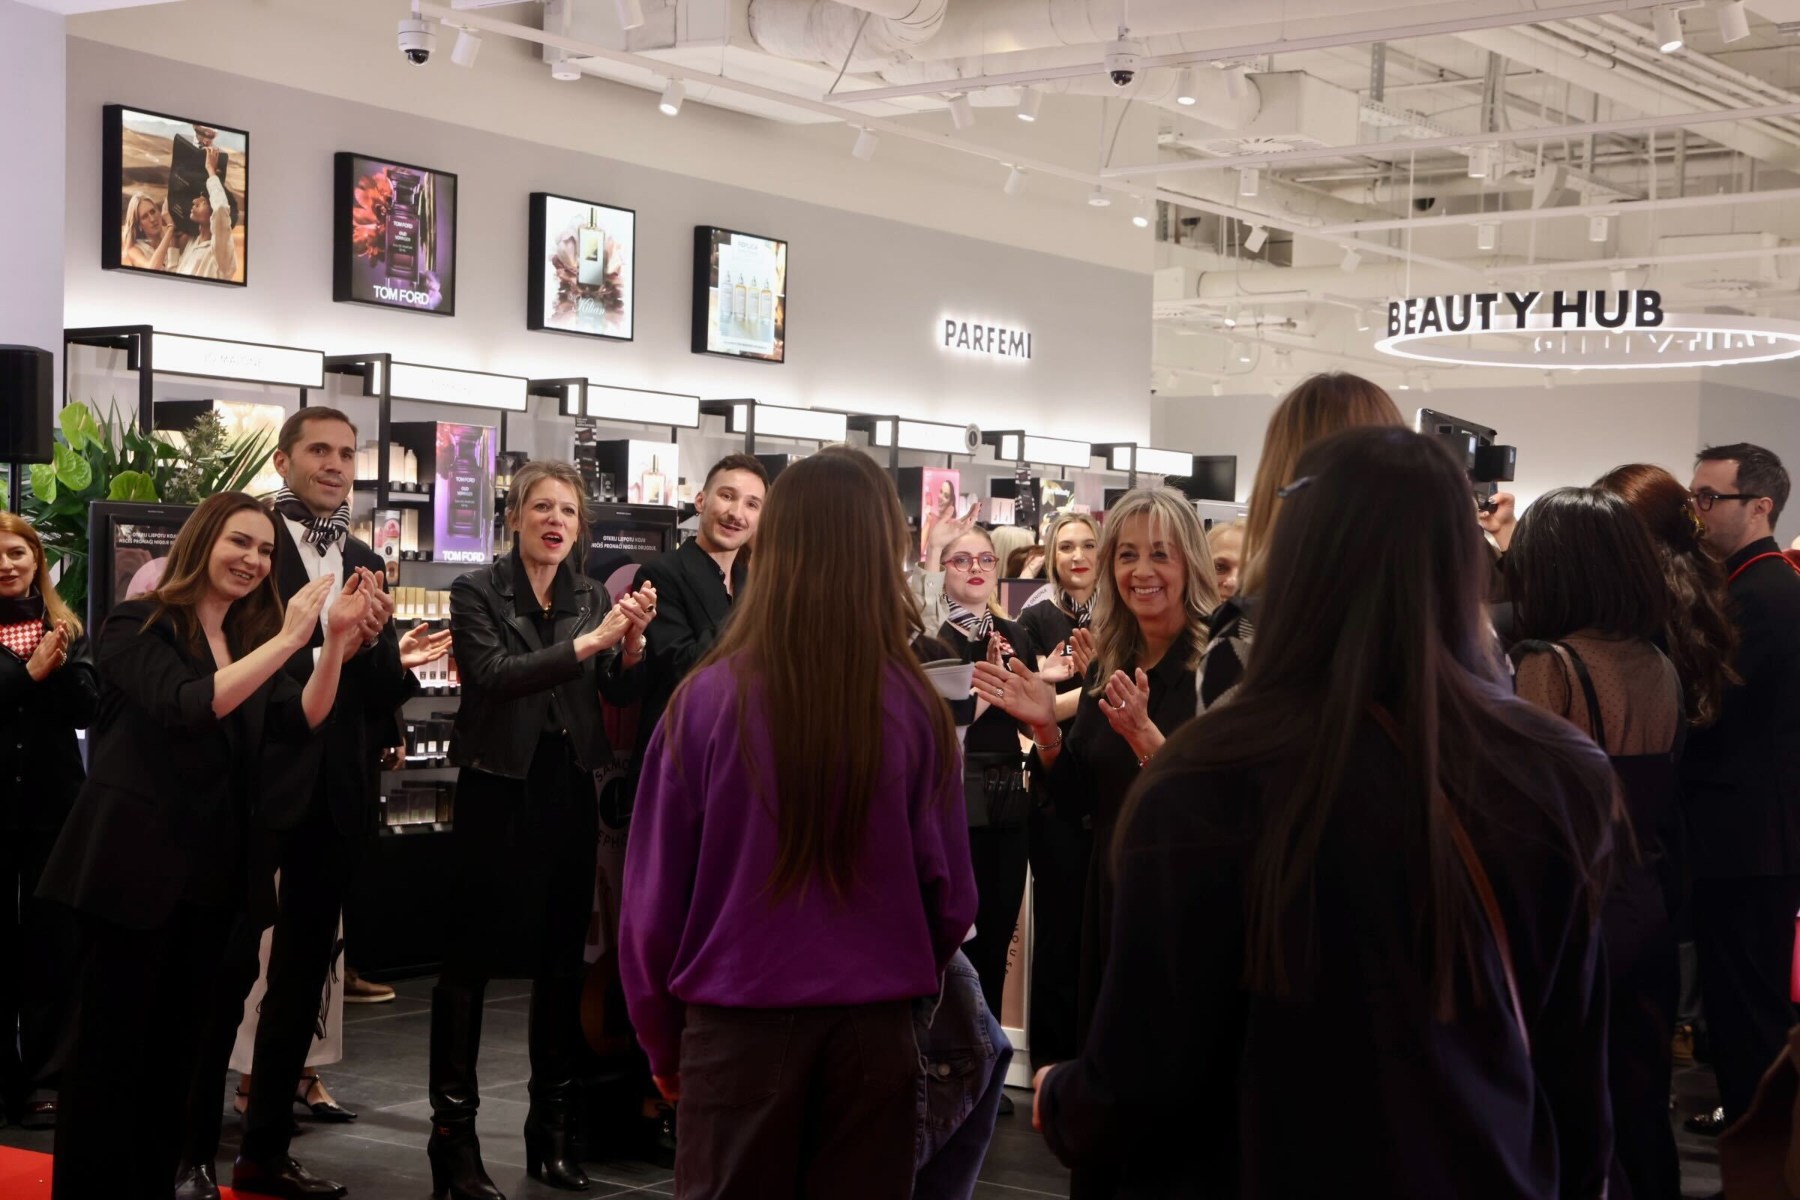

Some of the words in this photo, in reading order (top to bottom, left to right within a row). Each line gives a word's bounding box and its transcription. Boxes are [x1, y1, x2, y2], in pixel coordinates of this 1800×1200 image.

[373, 285, 398, 301] TOM
[399, 289, 430, 305] FORD
[1387, 291, 1542, 337] BEAUTY
[1552, 290, 1664, 328] HUB
[945, 319, 1032, 359] PARFEMI
[442, 550, 461, 561] TOM
[462, 551, 485, 562] FORD
